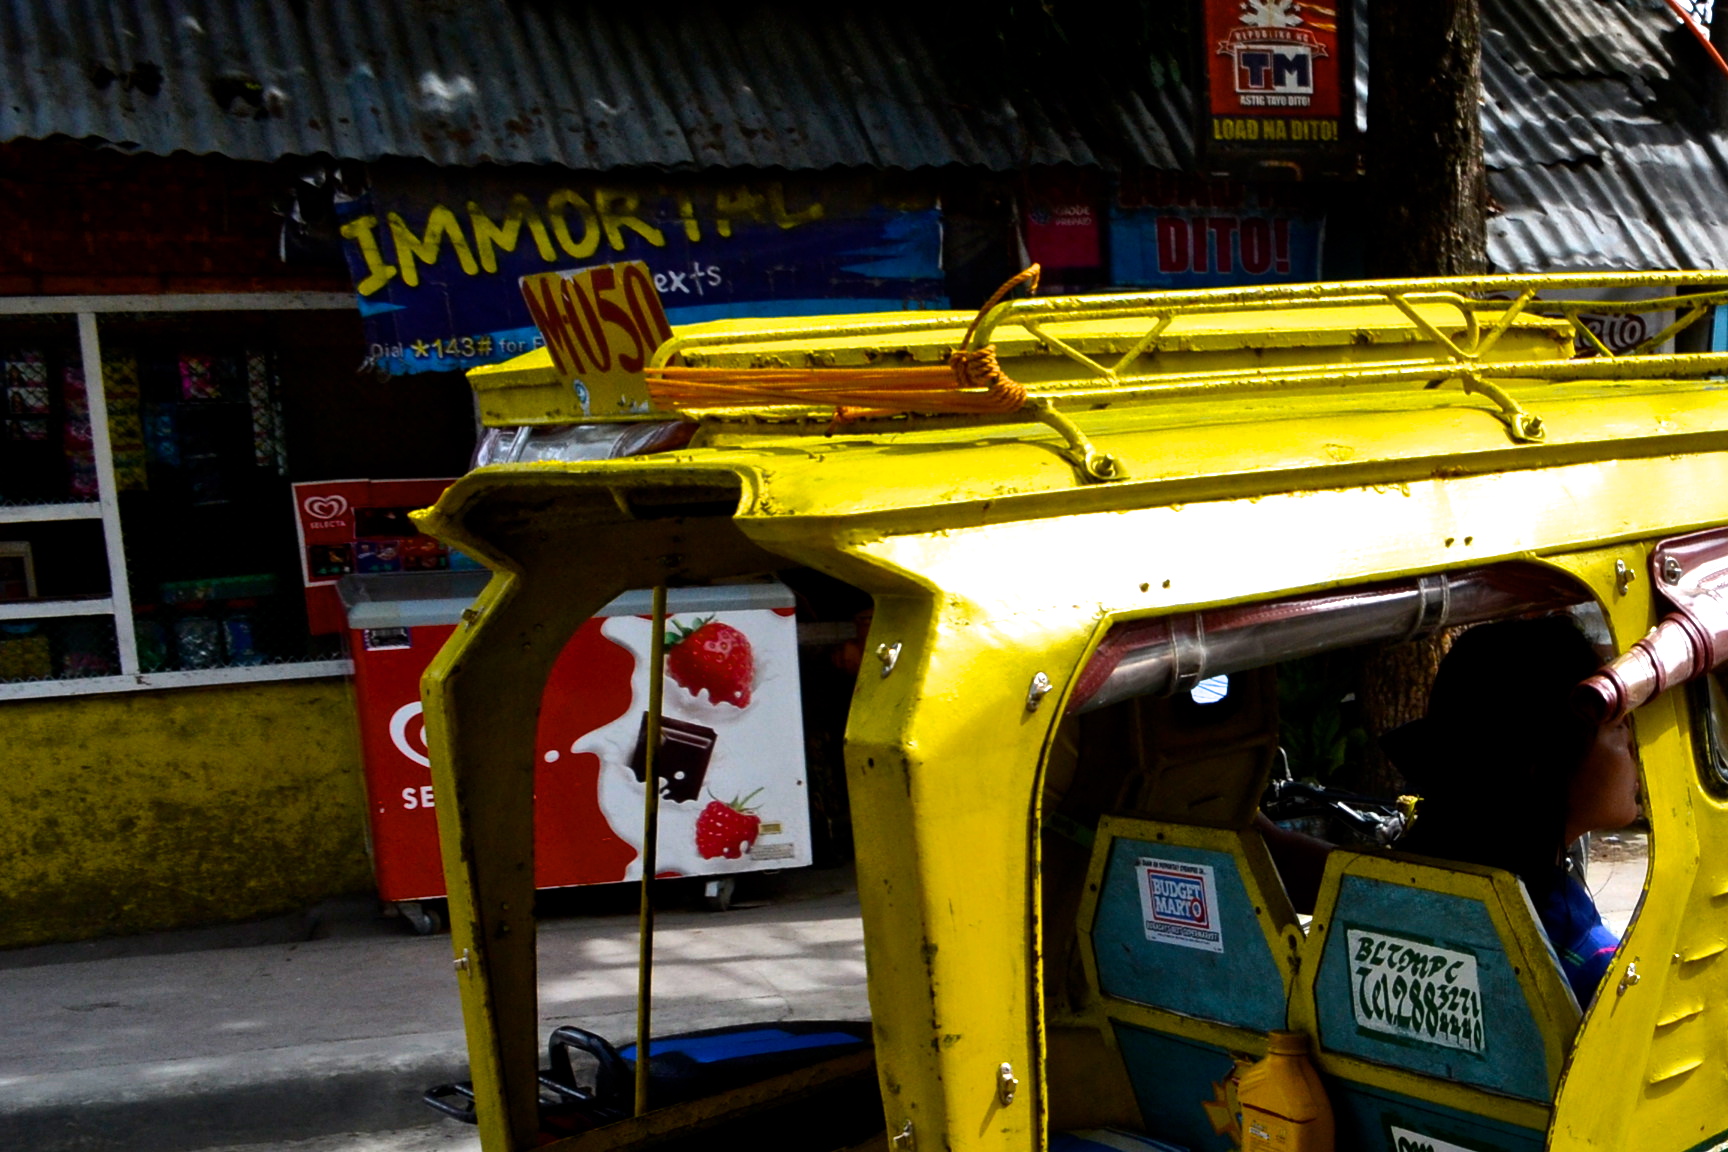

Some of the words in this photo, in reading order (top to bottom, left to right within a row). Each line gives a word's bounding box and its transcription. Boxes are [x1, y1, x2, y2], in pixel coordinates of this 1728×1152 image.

[1240, 52, 1310, 88] TM
[1240, 95, 1265, 106] ASTIG
[1265, 95, 1287, 106] TAYO
[1288, 95, 1311, 106] DITO!
[1213, 118, 1259, 140] LOAD
[1263, 119, 1288, 140] NA
[1291, 120, 1339, 141] DITO!
[1156, 217, 1290, 274] DITO!
[653, 262, 722, 296] exts
[499, 340, 525, 353] for
[310, 520, 346, 529] SELECTA
[1153, 878, 1200, 899] BUDGET
